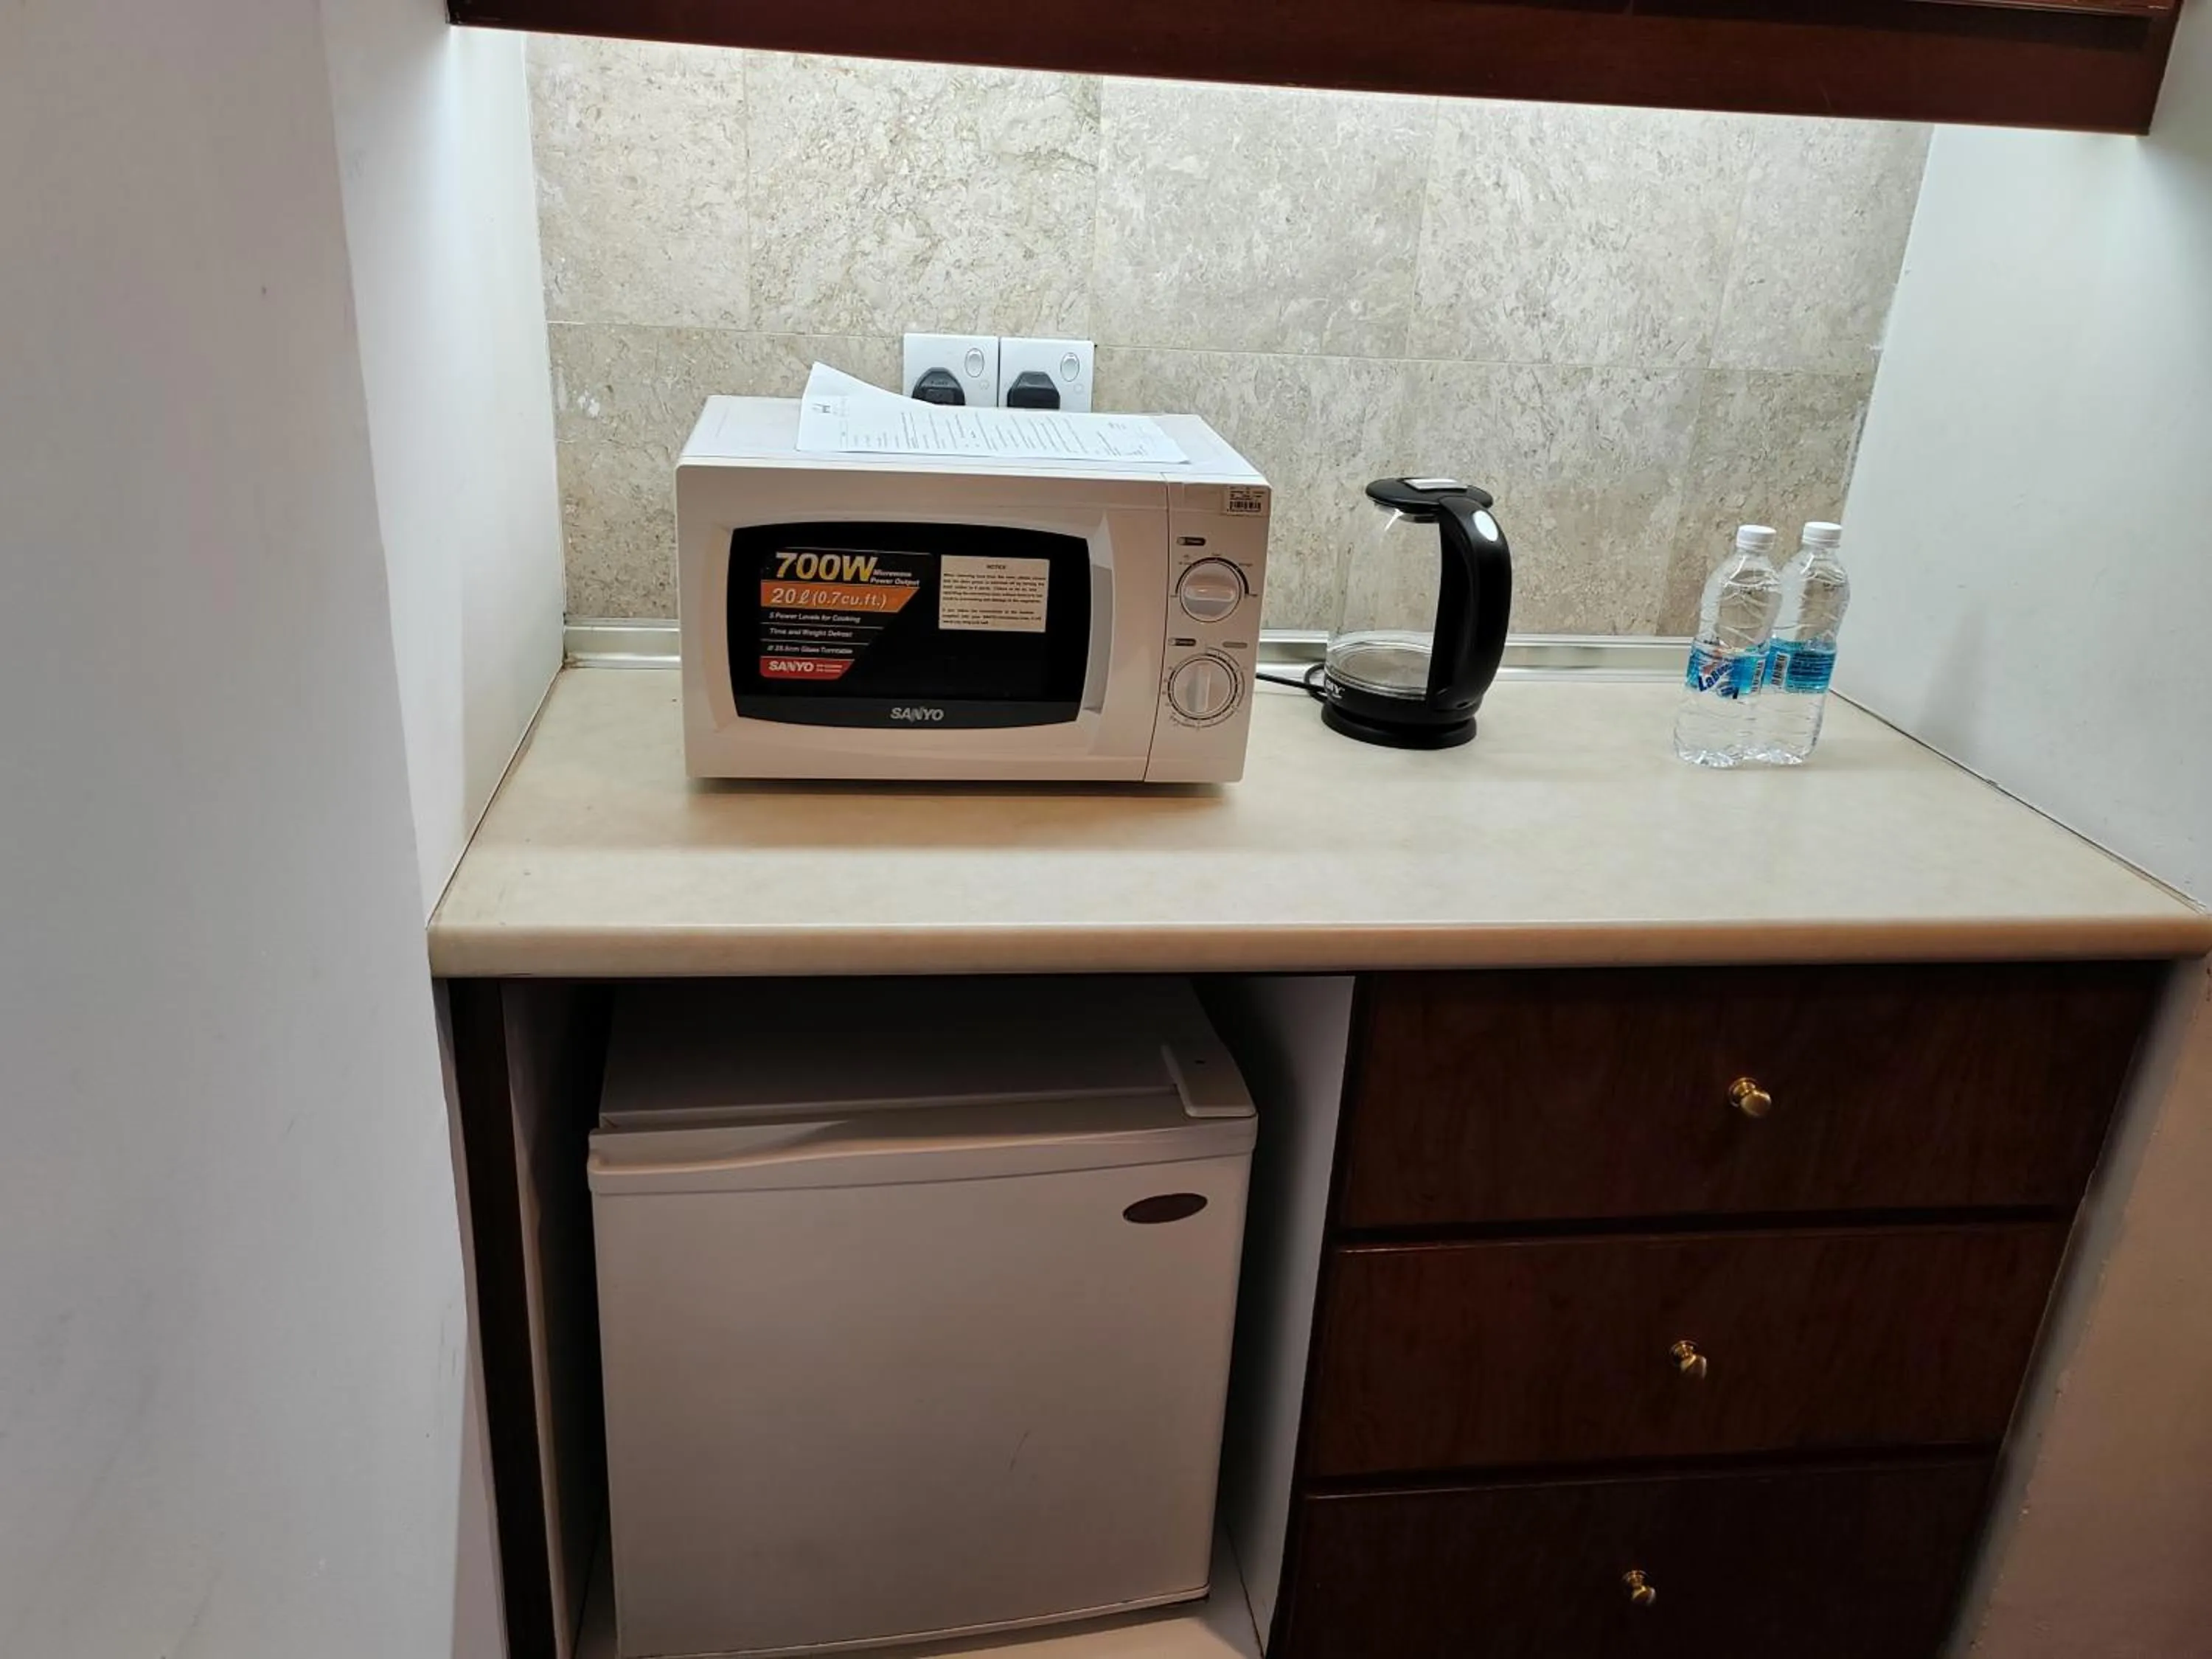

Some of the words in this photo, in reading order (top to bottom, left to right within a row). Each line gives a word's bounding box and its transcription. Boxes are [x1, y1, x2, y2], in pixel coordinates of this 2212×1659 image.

[776, 552, 878, 582] 700W
[873, 568, 912, 578] Microwave
[894, 578, 921, 587] Output
[775, 612, 798, 620] Power
[799, 613, 821, 621] Levels
[821, 613, 832, 622] for
[832, 614, 862, 624] Cooking
[802, 629, 827, 637] Weight
[827, 630, 854, 638] Defrost
[768, 660, 815, 673] SANYO
[890, 706, 945, 723] SANYO
